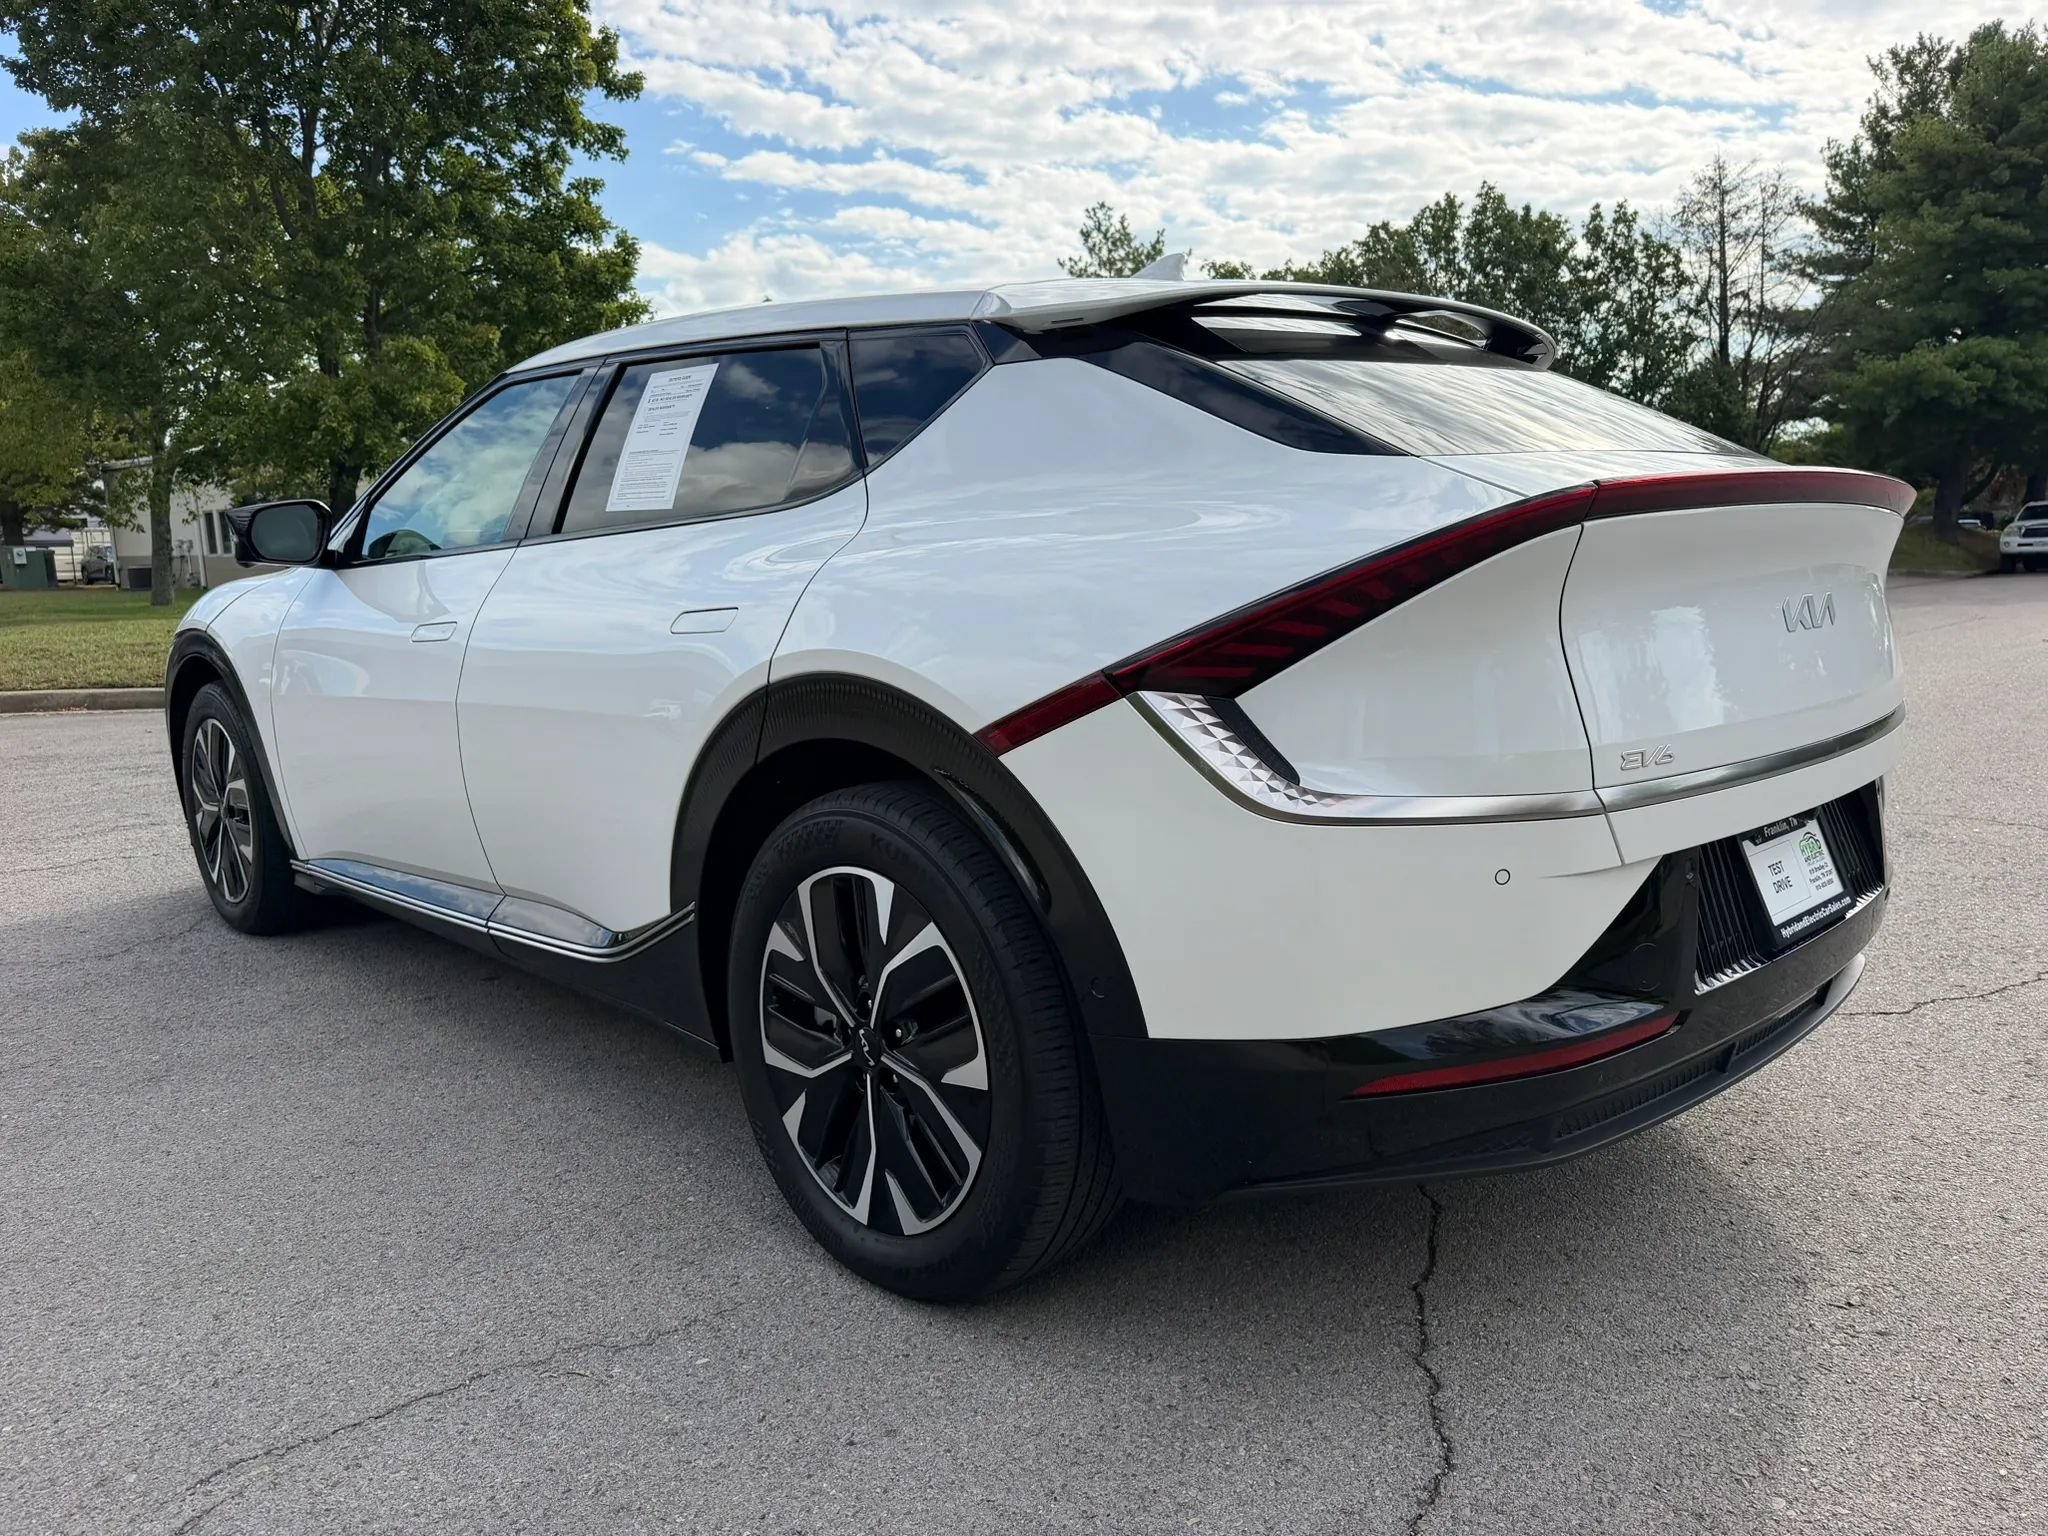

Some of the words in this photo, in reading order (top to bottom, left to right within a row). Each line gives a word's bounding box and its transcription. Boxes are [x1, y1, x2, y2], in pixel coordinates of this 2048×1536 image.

[1620, 744, 1675, 771] EV6
[1768, 861, 1784, 876] TEST
[1772, 876, 1793, 894] DRIVE
